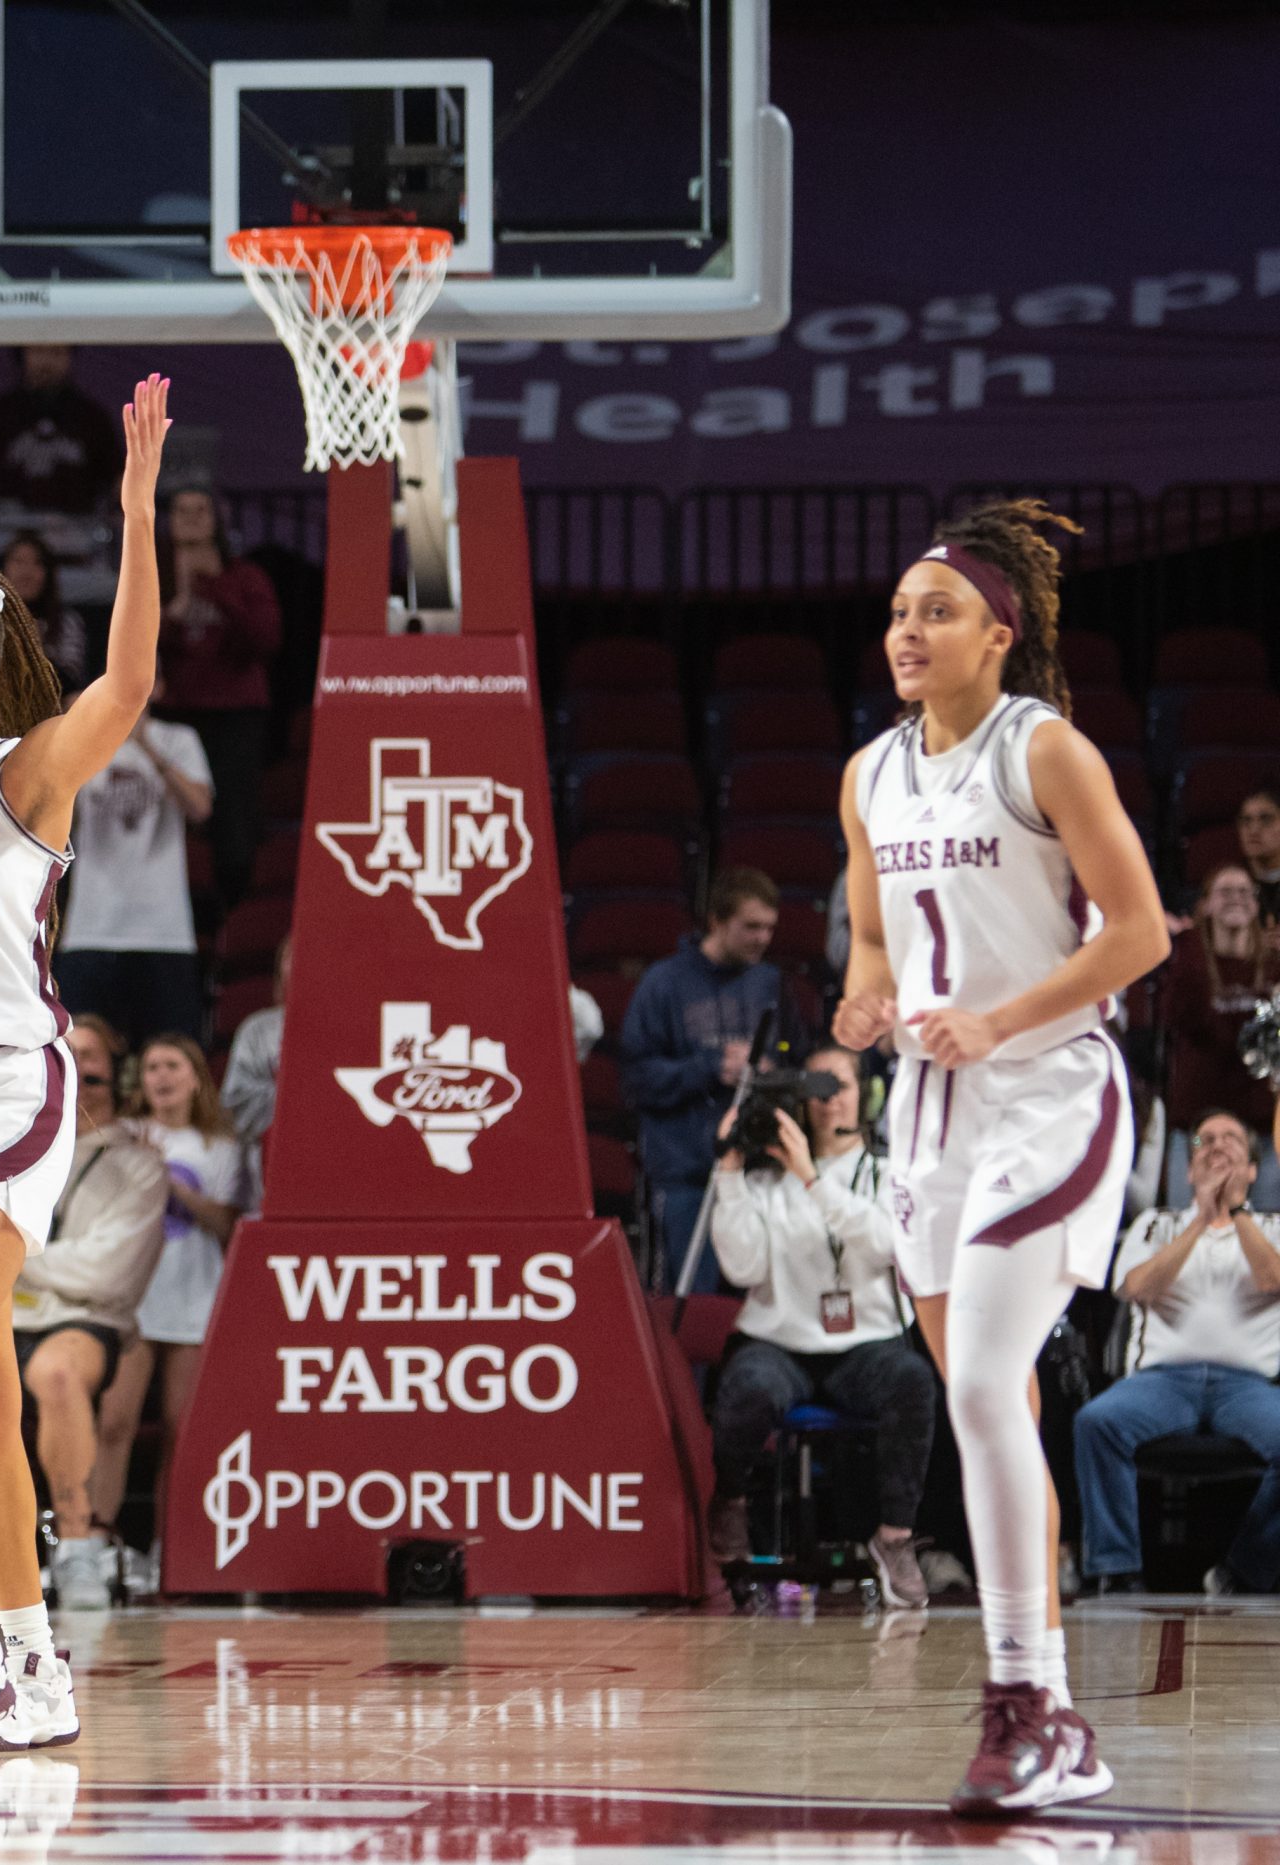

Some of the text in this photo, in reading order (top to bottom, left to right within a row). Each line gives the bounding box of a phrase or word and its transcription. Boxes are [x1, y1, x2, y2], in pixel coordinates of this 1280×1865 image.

[457, 349, 1054, 443] Health
[875, 836, 1000, 875] EXAS A&M
[914, 888, 950, 996] 1
[392, 1067, 496, 1110] Ford
[266, 1252, 577, 1322] WELLS
[275, 1343, 579, 1414] FARGO
